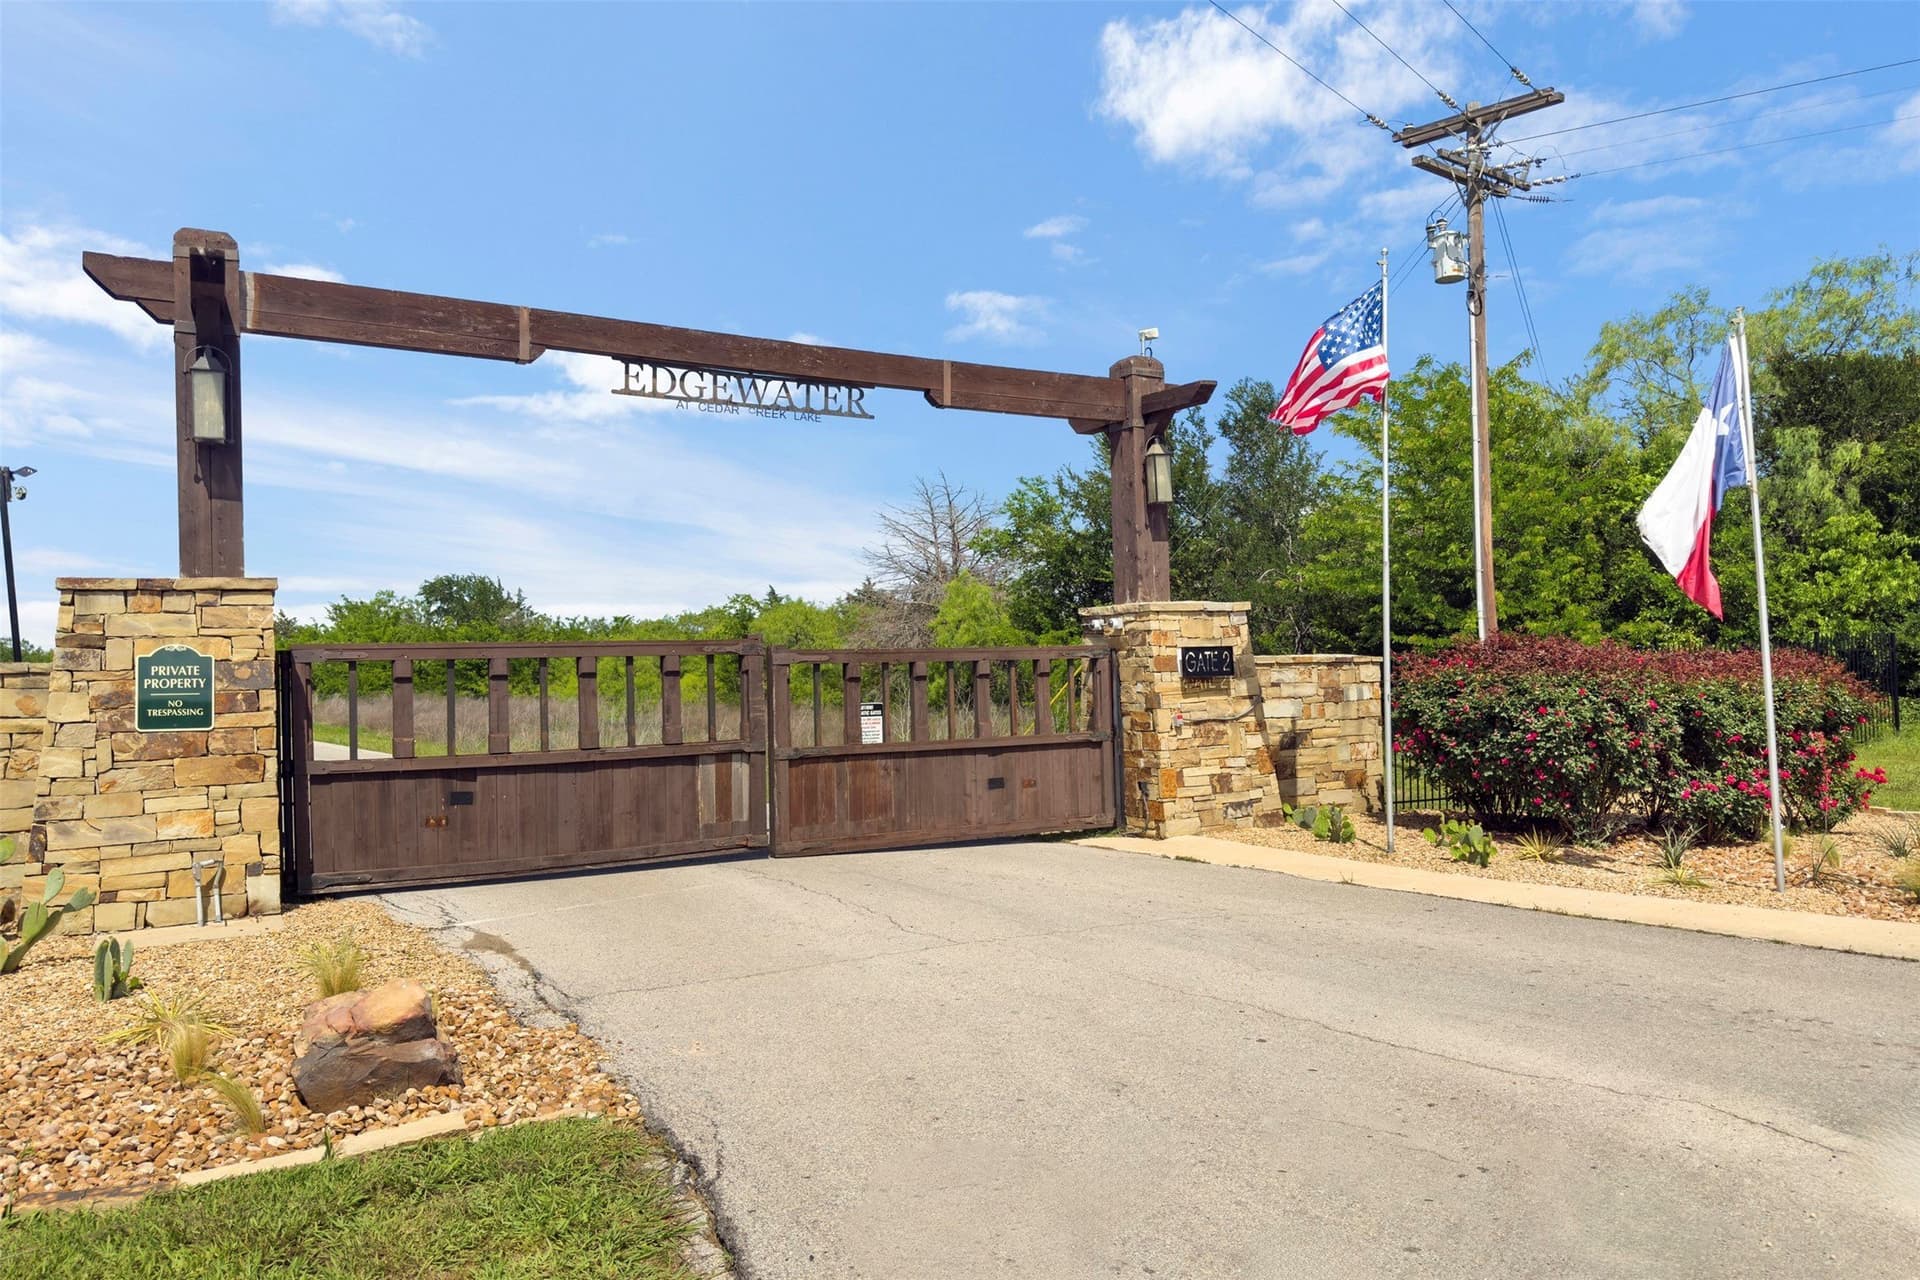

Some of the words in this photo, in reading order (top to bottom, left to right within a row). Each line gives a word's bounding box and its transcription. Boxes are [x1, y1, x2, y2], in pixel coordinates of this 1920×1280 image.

[621, 359, 873, 418] EDGEWATER
[676, 400, 691, 410] AT
[698, 402, 739, 415] CEDAR
[749, 407, 787, 419] CREEK
[794, 411, 822, 423] LAKE
[1185, 651, 1219, 672] GATE
[1222, 650, 1230, 671] 2
[151, 665, 200, 676] PRIVATE
[143, 678, 206, 689] PROPERTY
[167, 699, 183, 708] NO
[147, 708, 204, 717] TRESPASSING
